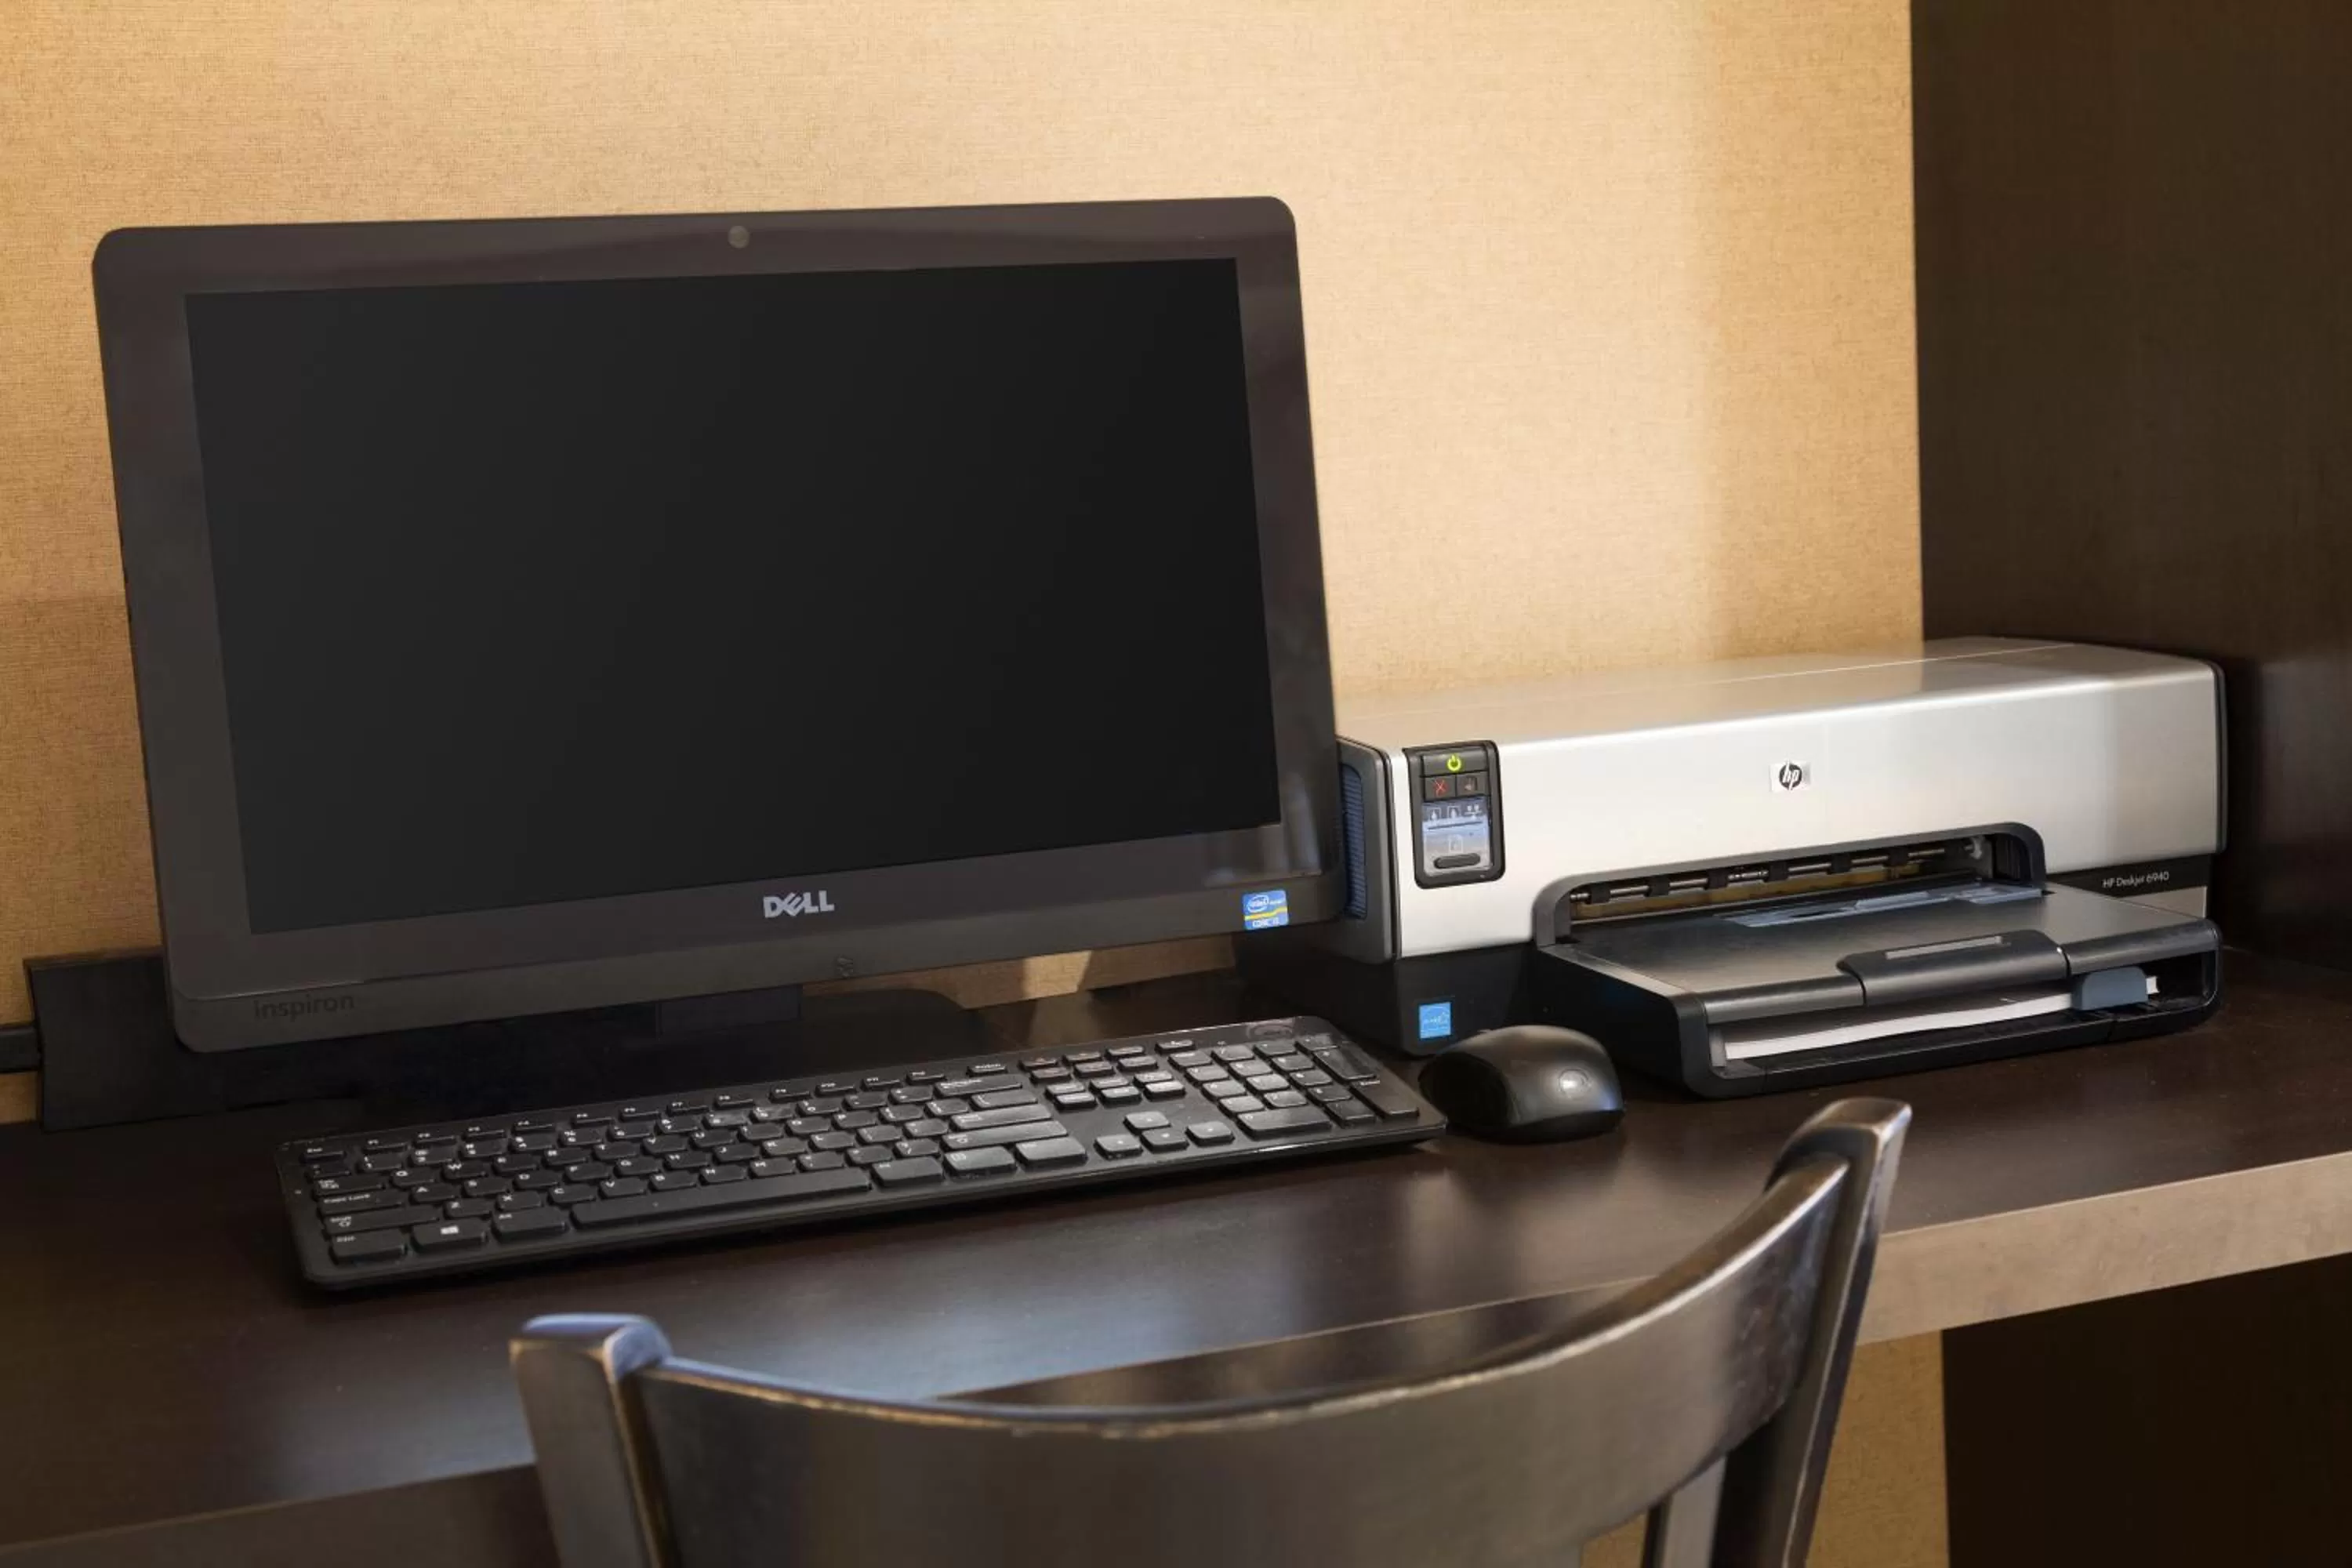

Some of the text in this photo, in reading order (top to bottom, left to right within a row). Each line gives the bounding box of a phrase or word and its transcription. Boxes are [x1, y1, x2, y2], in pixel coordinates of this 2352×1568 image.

[1780, 761, 1802, 790] hp
[2147, 871, 2169, 884] 6940
[763, 890, 835, 918] DELL
